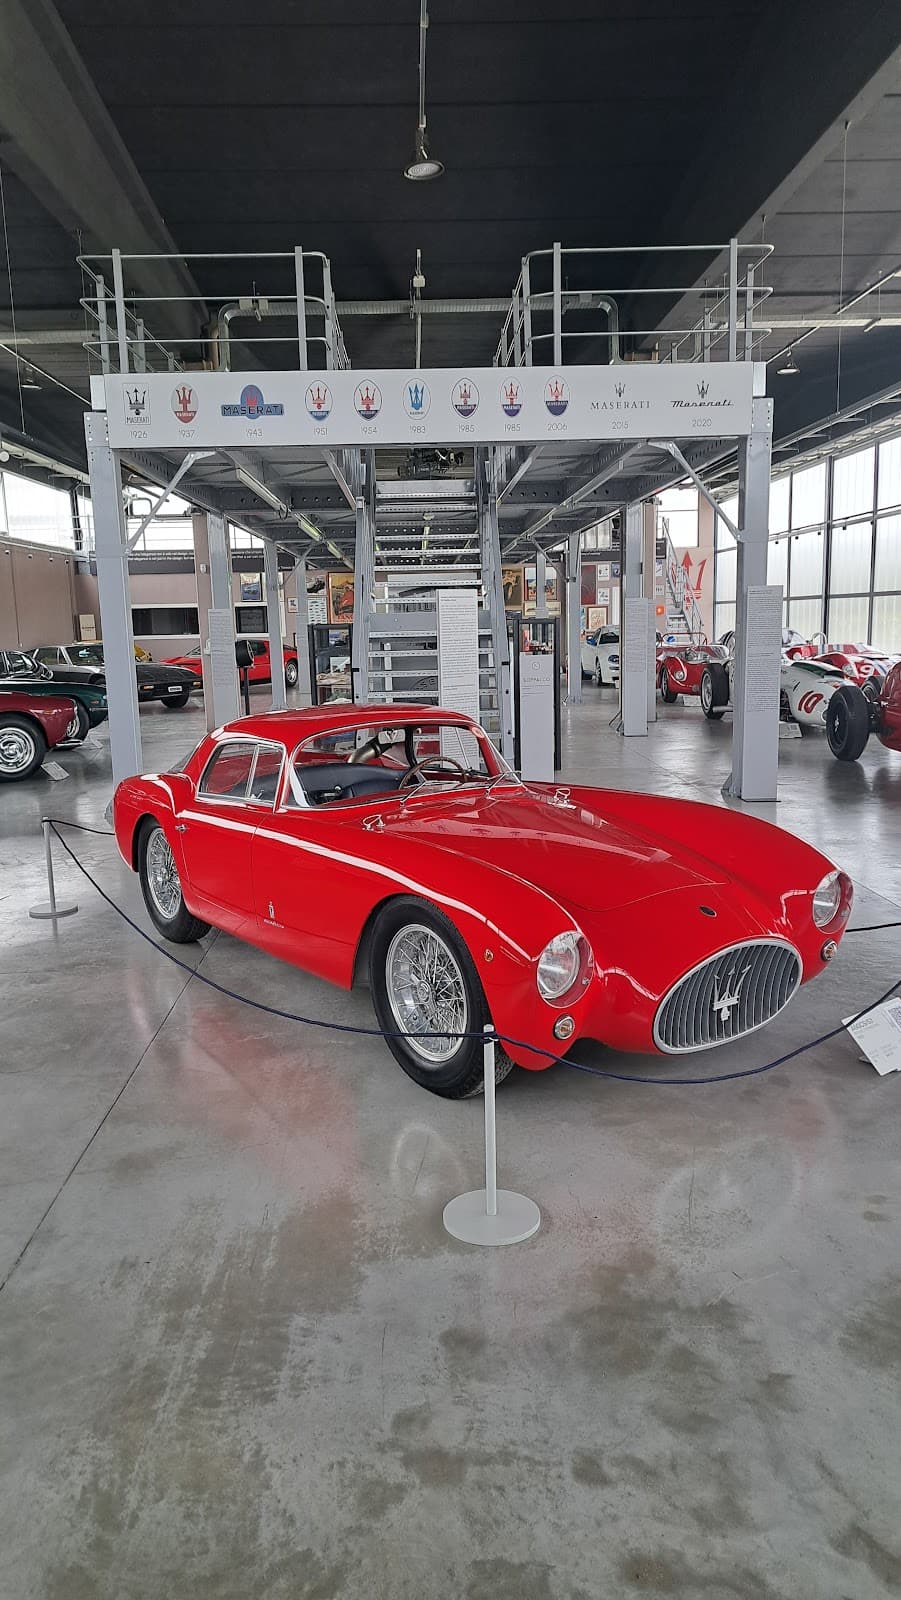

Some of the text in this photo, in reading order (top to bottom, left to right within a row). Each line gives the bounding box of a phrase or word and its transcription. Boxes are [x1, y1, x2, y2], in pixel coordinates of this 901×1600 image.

[590, 401, 650, 410] MASERATI
[669, 399, 734, 408] Maserati
[223, 405, 284, 415] MASERATI
[126, 416, 149, 424] MASERATI
[691, 418, 712, 427] 2020
[409, 425, 426, 434] 1983
[459, 424, 475, 432] 1985
[504, 423, 521, 432] 1985
[547, 422, 567, 431] 2006
[611, 421, 629, 430] 2015
[130, 430, 148, 439] 1926
[179, 429, 195, 438] 1937
[245, 428, 263, 437] 1943
[313, 427, 328, 435] 1951
[797, 690, 824, 715] 10
